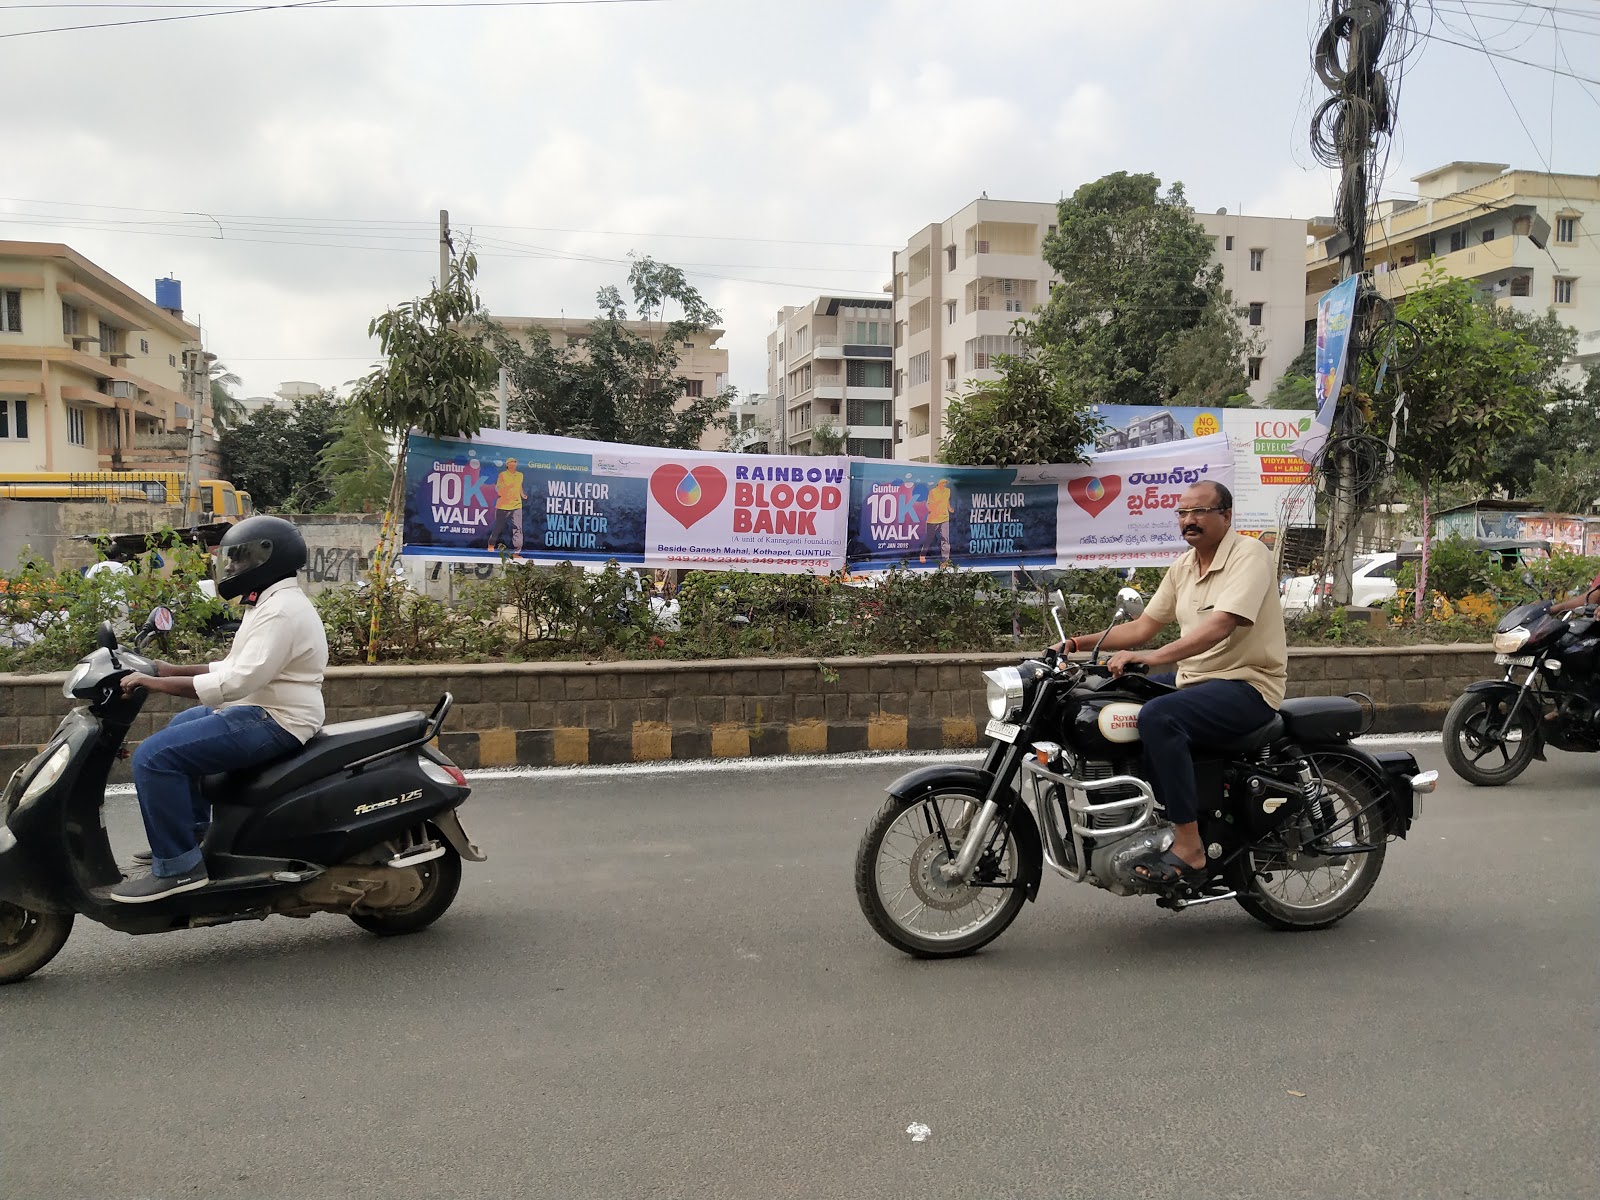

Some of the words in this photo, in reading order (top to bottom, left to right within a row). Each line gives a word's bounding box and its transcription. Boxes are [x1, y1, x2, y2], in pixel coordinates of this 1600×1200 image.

[1199, 417, 1214, 426] NO
[1255, 421, 1300, 438] ICON
[1196, 427, 1216, 436] GST
[433, 461, 465, 473] Guntur
[528, 460, 551, 470] Grand
[554, 463, 589, 472] Welcome
[735, 465, 844, 484] RAINBOW
[427, 472, 489, 508] 10K
[547, 480, 583, 498] WALK
[584, 482, 609, 500] FOR
[734, 482, 842, 511] BLOOD
[872, 484, 901, 493] Guntur
[546, 497, 603, 516] HEALTH...
[971, 493, 1003, 508] WALK
[1003, 492, 1025, 508] FOR
[431, 506, 489, 526] WALK
[867, 493, 921, 524] 10K
[969, 508, 1019, 524] HEALTH...
[546, 514, 581, 532] WALK
[583, 516, 608, 533] FOR
[732, 508, 817, 536] BANK
[462, 527, 476, 535] 2019
[870, 524, 920, 541] WALK
[970, 523, 1001, 539] WALK
[1002, 523, 1024, 538] FOR
[545, 531, 606, 549] GUNTUR...
[765, 537, 802, 546] Kanneganti
[969, 538, 1022, 554] GUNTUR...
[657, 544, 687, 552] Beside
[689, 545, 722, 554] Ganesh
[723, 546, 750, 555] Mahal,
[753, 547, 792, 557] Kothapet,
[1098, 553, 1118, 561] 245
[1150, 551, 1170, 559] 949
[693, 555, 714, 563] 245
[752, 557, 774, 565] 949
[776, 558, 798, 566] 246
[800, 559, 829, 568] 2345
[353, 797, 398, 815] Access
[400, 788, 423, 804] 125
